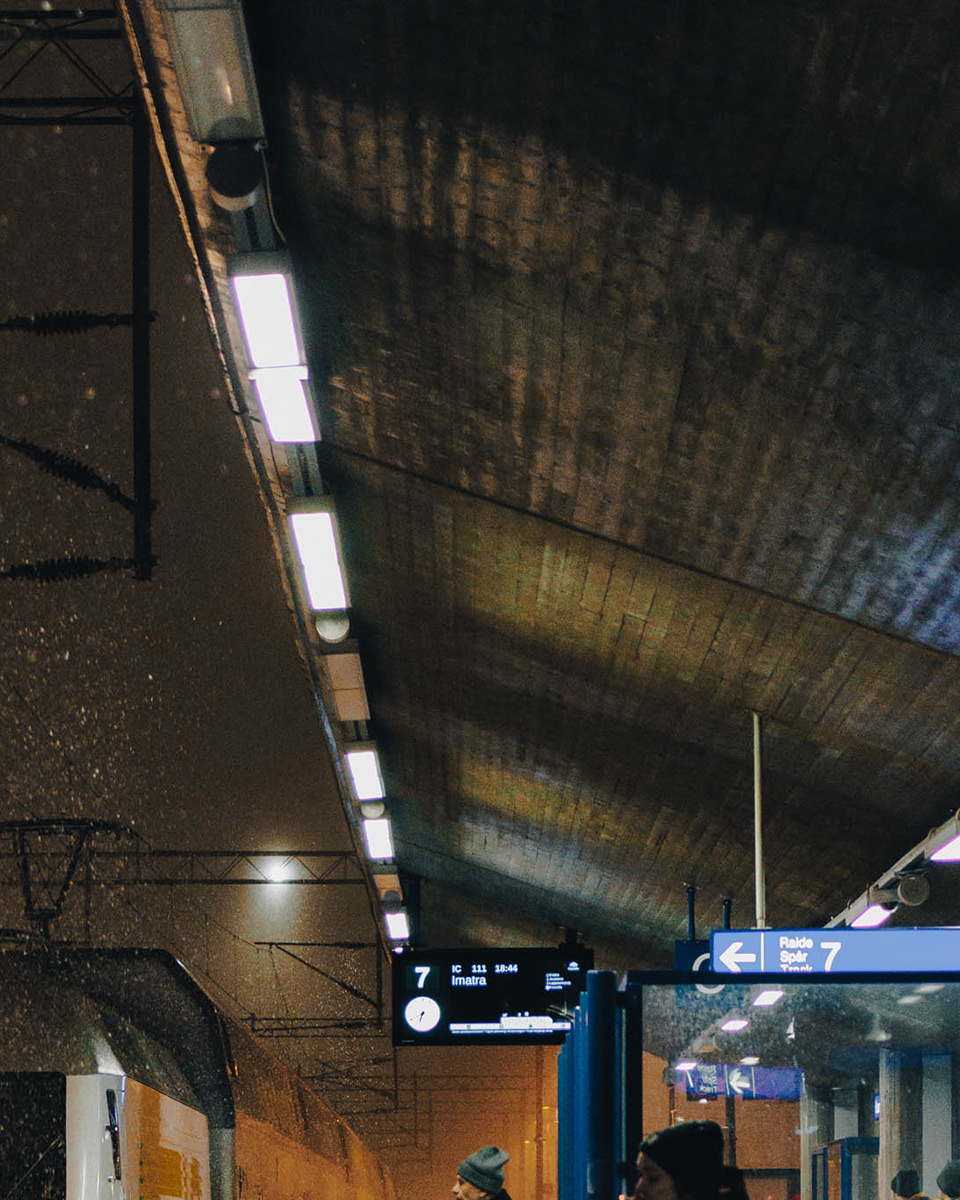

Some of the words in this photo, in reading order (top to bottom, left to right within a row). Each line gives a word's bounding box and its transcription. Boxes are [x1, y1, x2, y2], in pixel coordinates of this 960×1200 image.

[780, 936, 813, 949] Raide
[780, 950, 808, 965] Spår
[820, 941, 841, 972] 7
[452, 964, 462, 973] IC
[471, 964, 487, 973] 111
[495, 964, 519, 973] 18:44
[414, 966, 431, 989] 7
[452, 975, 487, 986] Imatra
